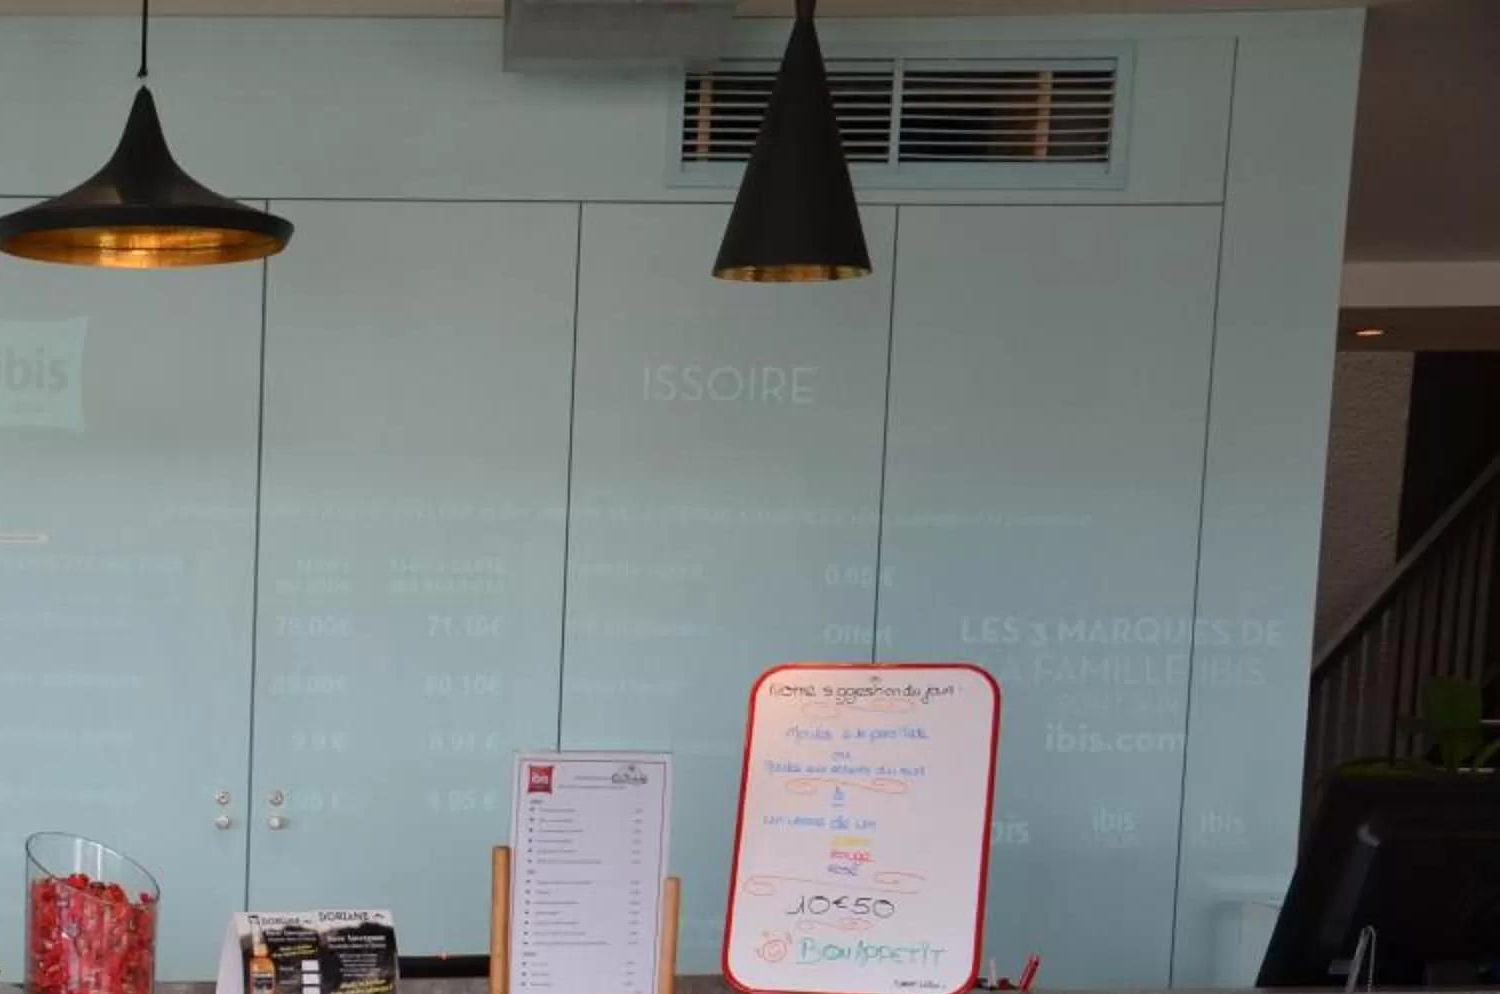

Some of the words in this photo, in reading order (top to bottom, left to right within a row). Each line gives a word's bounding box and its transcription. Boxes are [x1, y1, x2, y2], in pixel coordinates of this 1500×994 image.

[643, 364, 820, 403] ISSOIRE
[960, 614, 1019, 644] LES
[1029, 620, 1048, 646] 3
[1057, 615, 1230, 647] MARQUES
[1241, 618, 1286, 647] DE
[1033, 654, 1187, 687] FAMILLE
[1045, 721, 1185, 753] ibis.com
